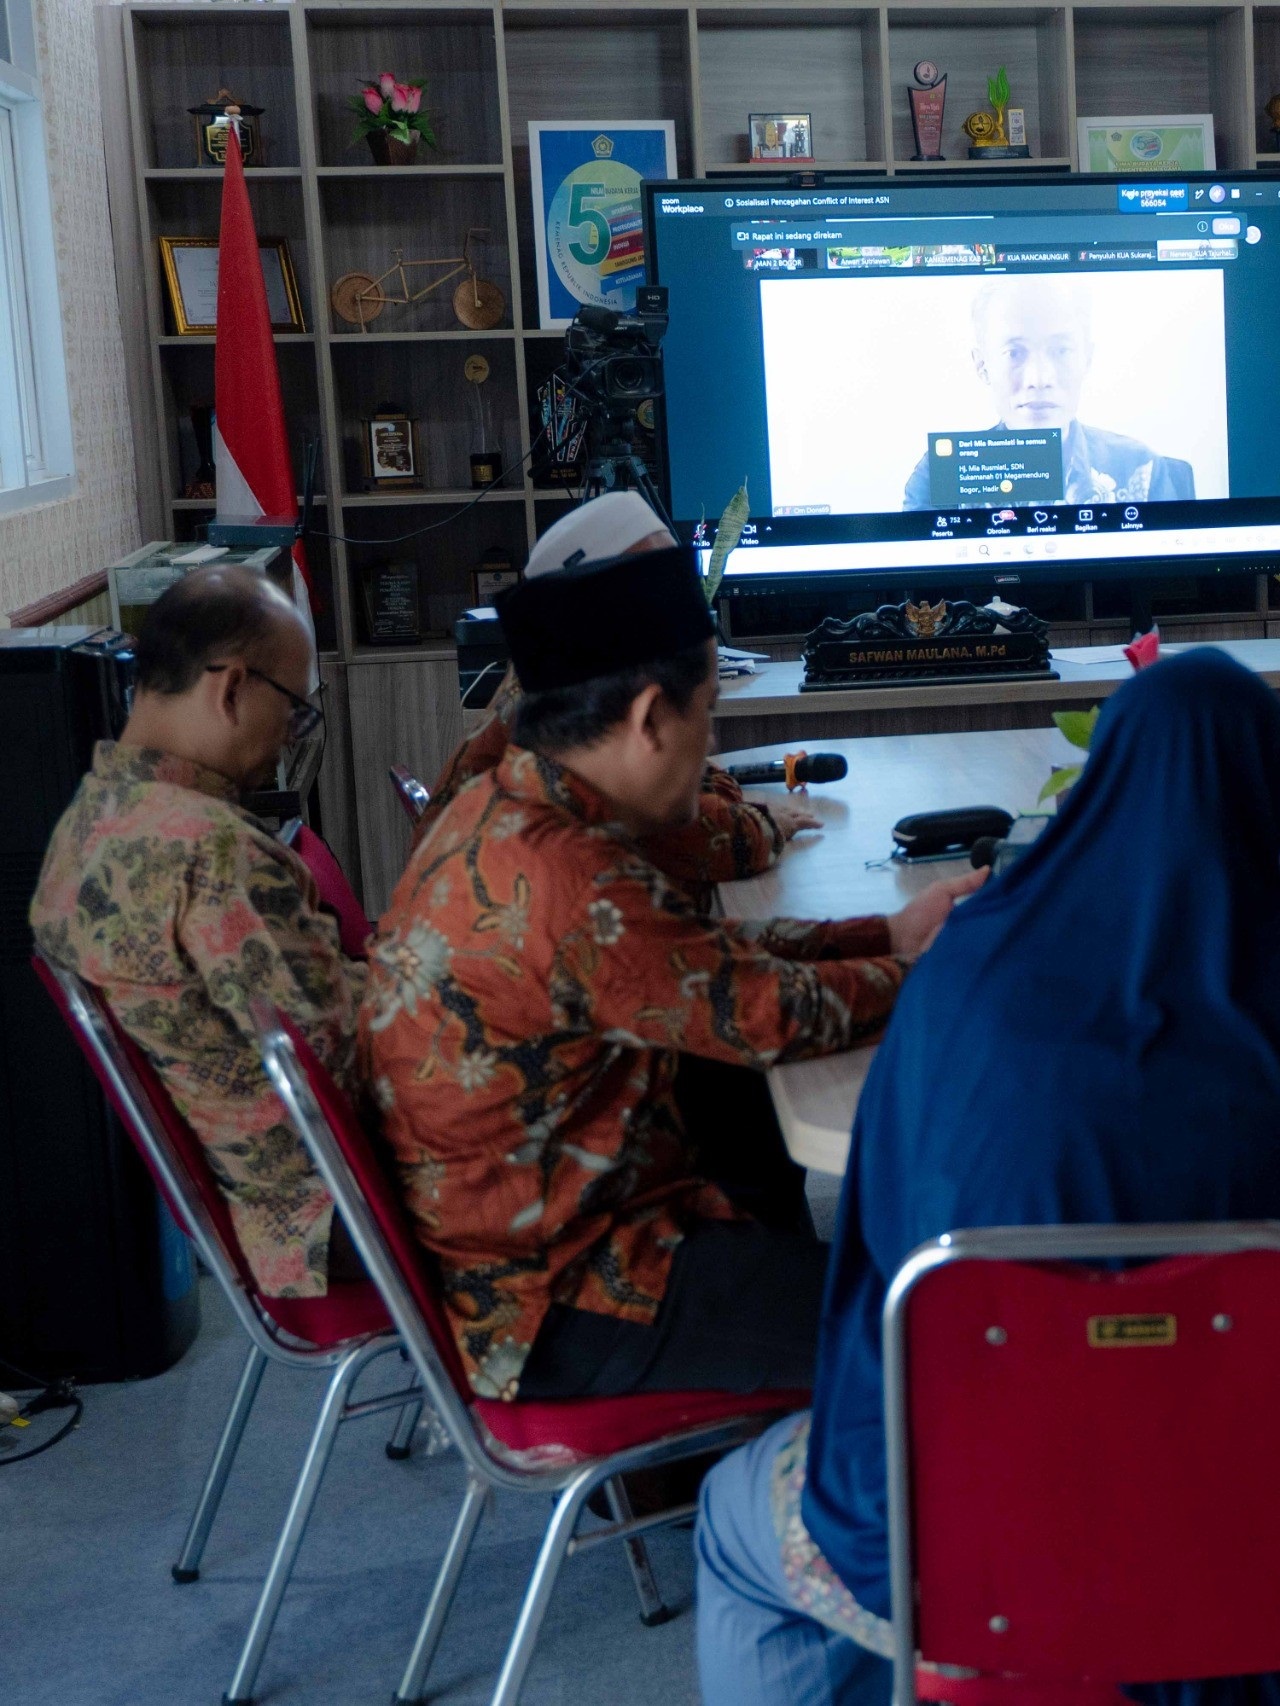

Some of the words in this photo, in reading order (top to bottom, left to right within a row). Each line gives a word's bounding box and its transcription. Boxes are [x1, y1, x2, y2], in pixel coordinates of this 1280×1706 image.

[605, 187, 624, 195] BUDAYA
[736, 198, 770, 207] Sosialisasi
[771, 197, 812, 208] Pencegahan
[813, 196, 839, 206] Conflict
[840, 196, 848, 205] of
[849, 196, 874, 205] Interest
[875, 196, 890, 205] ASN
[662, 204, 704, 214] Workplace
[752, 232, 774, 241] Rapat
[775, 232, 784, 240] ini
[785, 232, 812, 242] sedang
[813, 231, 843, 240] direkam
[969, 255, 981, 263] KAB
[1021, 253, 1069, 261] RANCABUNGUR
[1089, 252, 1116, 261] Penyuluh
[554, 221, 564, 259] KEMENAG
[561, 261, 581, 291] REPUBLIK
[583, 289, 618, 305] INDONESIA
[755, 259, 772, 268] MAN
[779, 259, 802, 267] BOGOR
[959, 440, 972, 448] Dari
[987, 438, 1015, 447] Rusmiati
[1025, 438, 1047, 446] semua
[959, 450, 979, 458] orang
[968, 464, 980, 472] Mia
[1010, 463, 1025, 471] SDN
[959, 473, 994, 481] Sukamanah
[995, 472, 1003, 480] 01
[1004, 471, 1050, 481] Megamendung
[982, 485, 999, 493] Hadir
[950, 516, 961, 524] 752
[1027, 526, 1039, 534] Beri
[1040, 525, 1057, 533] reaksi
[1075, 523, 1098, 532] Bagikan
[1121, 522, 1143, 530] Lainnya
[932, 530, 954, 538] Peserta
[987, 527, 1011, 535] Obrolan
[849, 649, 901, 663] SAFWAN
[975, 644, 1007, 657] M.Pd
